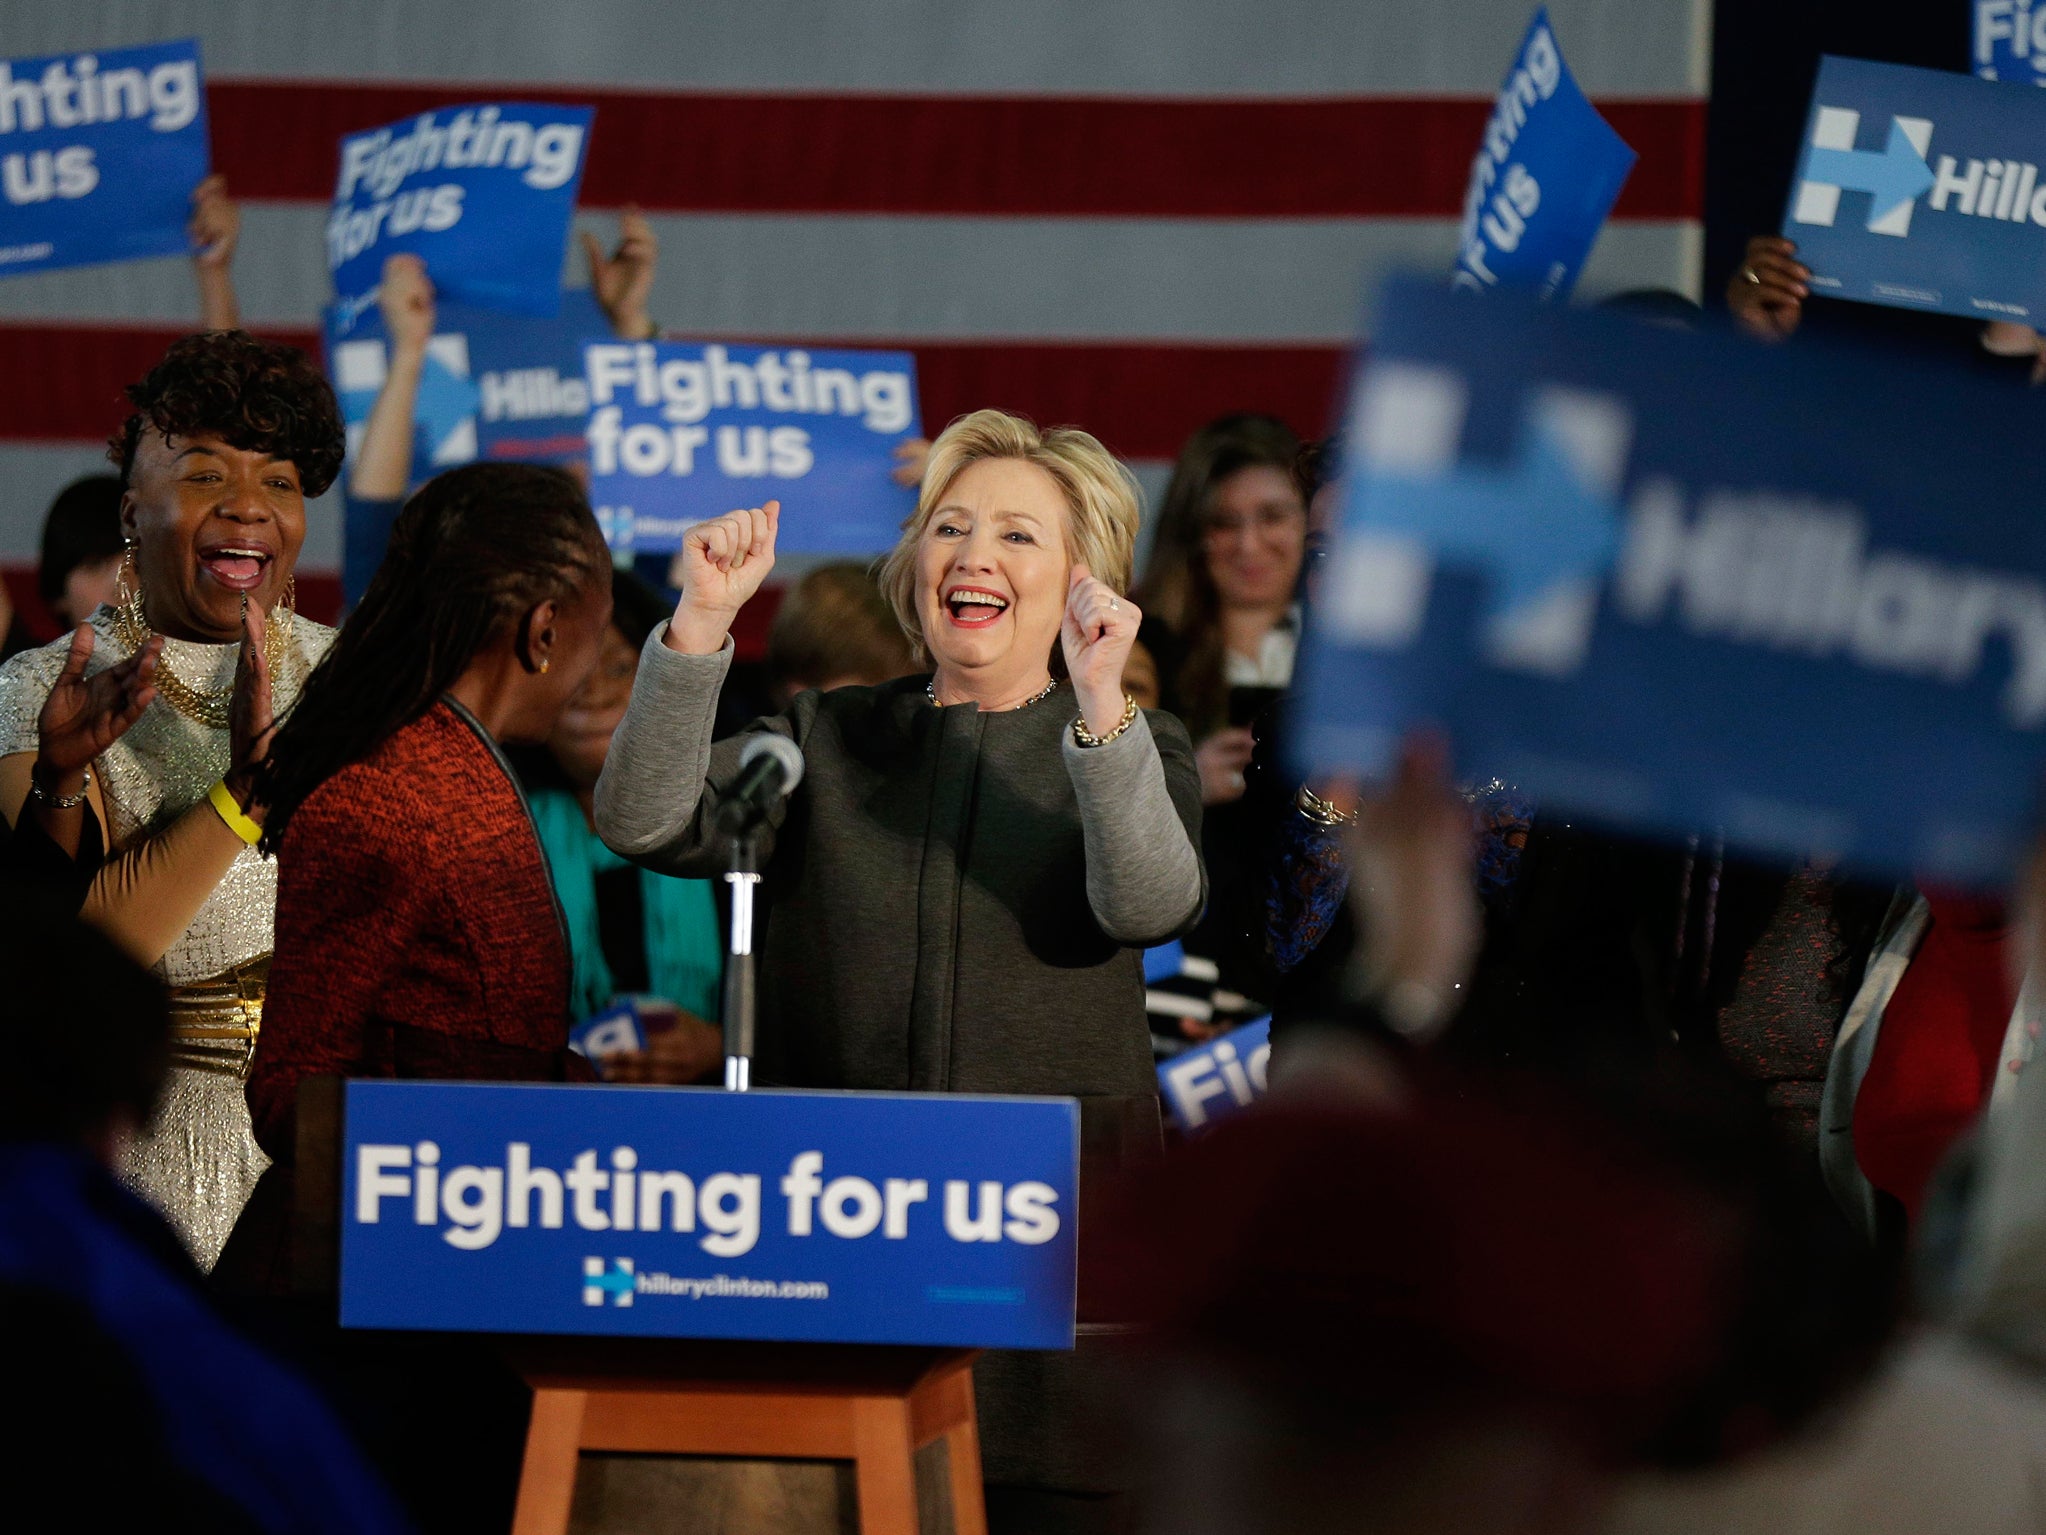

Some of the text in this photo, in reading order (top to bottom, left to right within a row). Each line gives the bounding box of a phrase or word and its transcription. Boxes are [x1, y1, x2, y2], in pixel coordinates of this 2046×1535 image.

[4, 145, 99, 205] us
[338, 104, 585, 202] Fighting
[386, 183, 466, 238] us
[1482, 162, 1541, 253] us
[585, 342, 912, 434] Fighting
[587, 404, 709, 477] for
[716, 424, 815, 479] us
[356, 1140, 1061, 1258] Fighting for us
[636, 1272, 829, 1300] hillaryclinton.com
